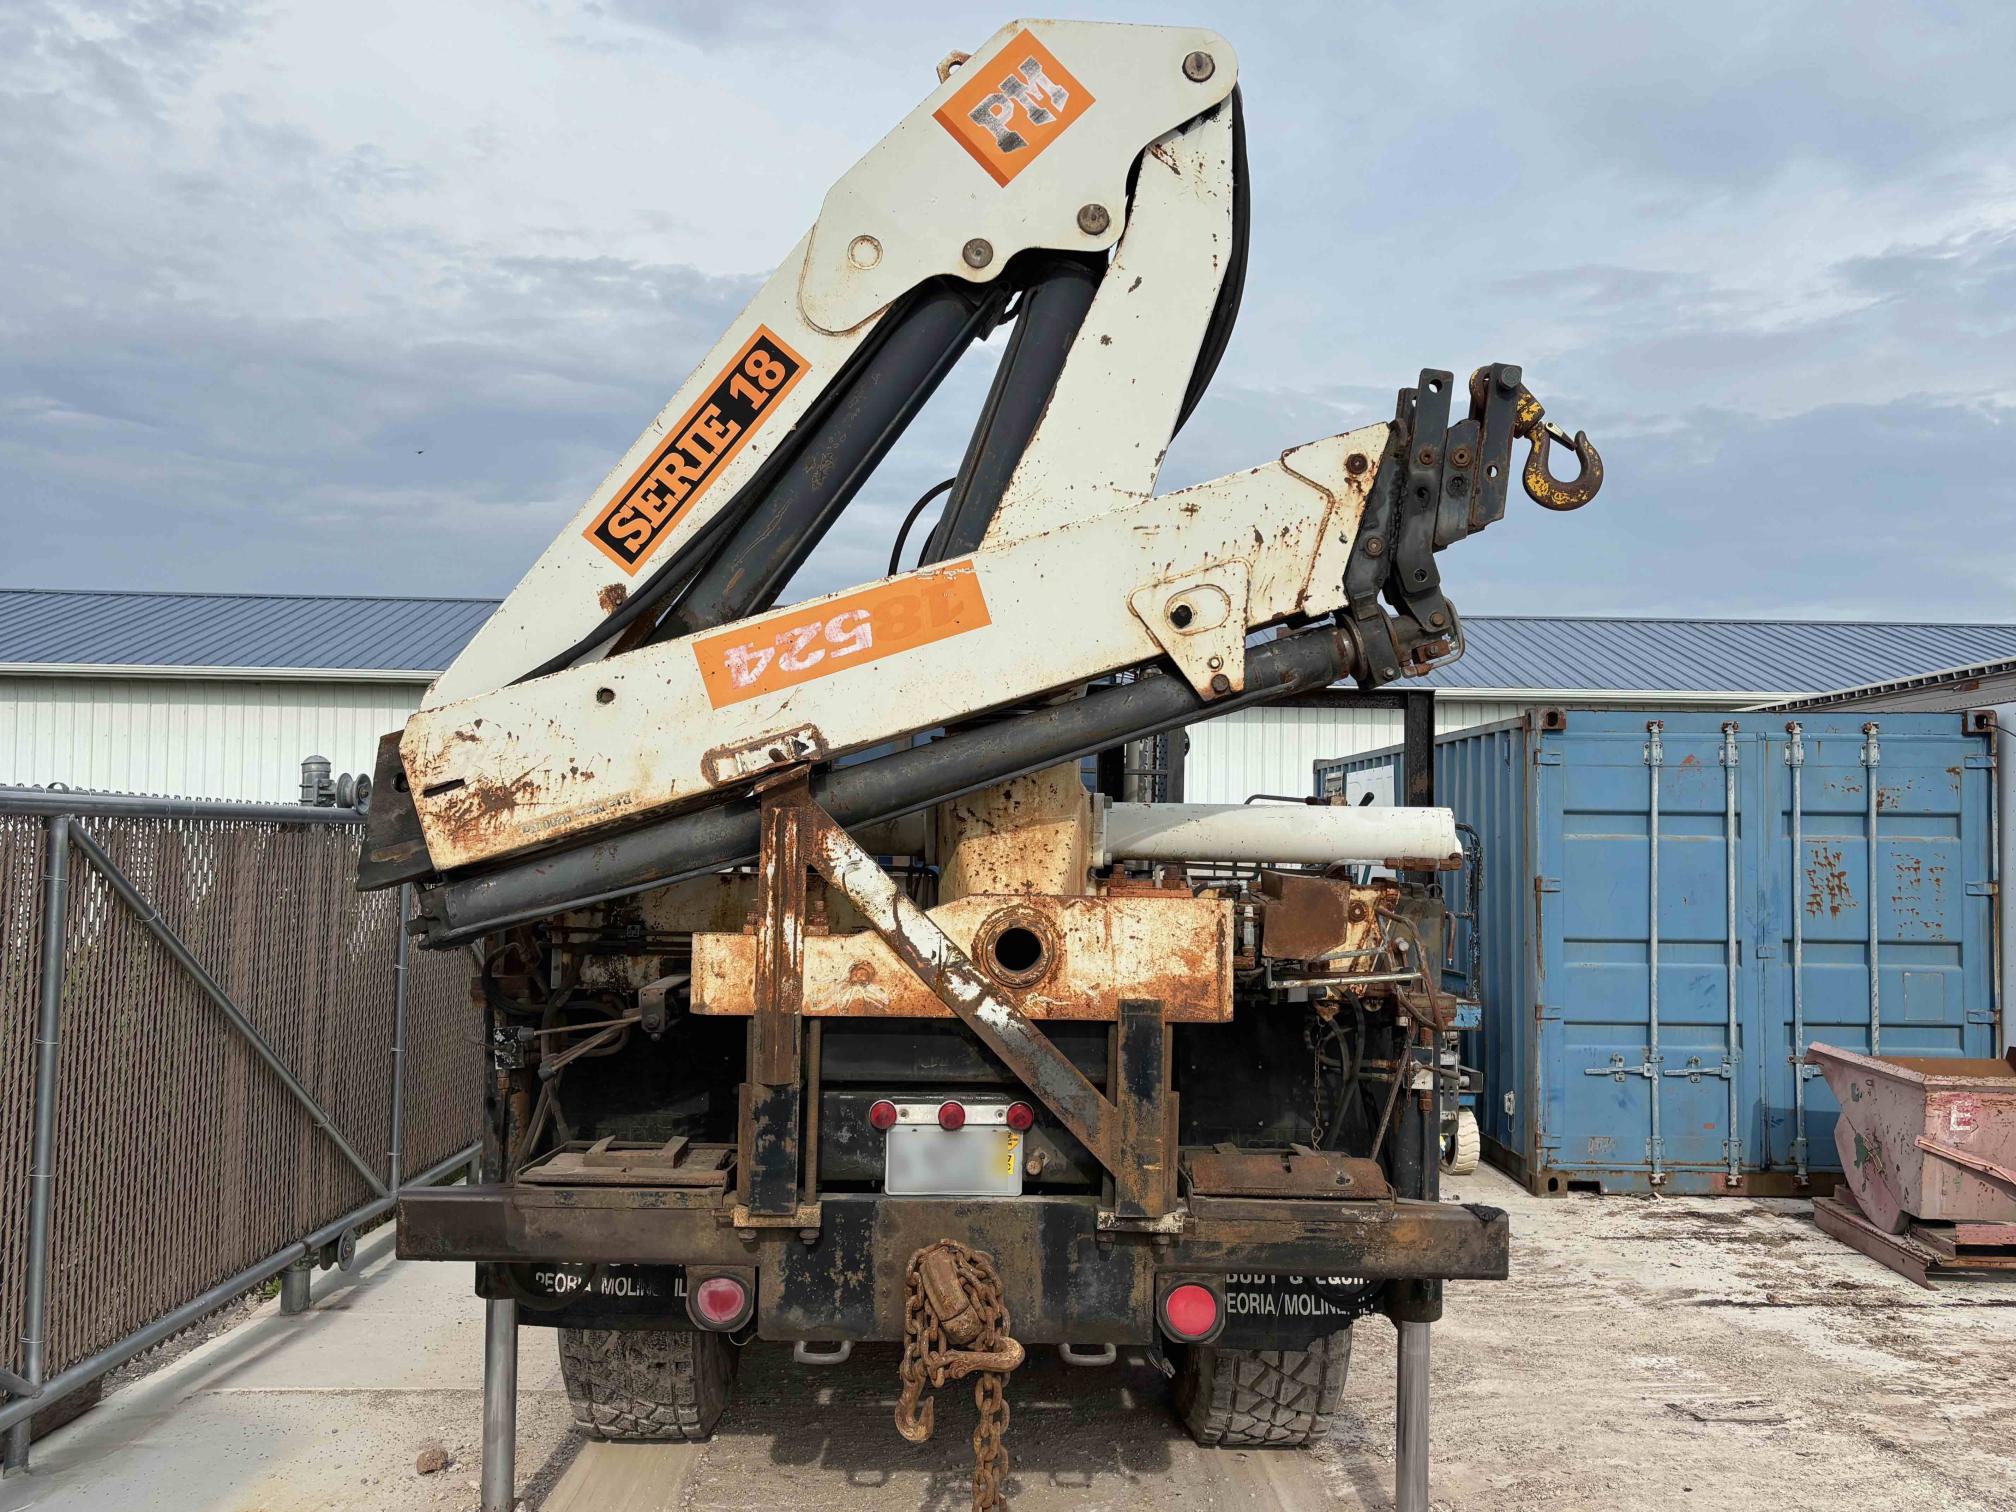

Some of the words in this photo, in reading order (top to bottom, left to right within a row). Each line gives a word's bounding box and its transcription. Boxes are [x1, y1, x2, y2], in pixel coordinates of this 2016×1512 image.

[968, 55, 1069, 153] PM
[607, 402, 742, 553] SERIE
[729, 349, 786, 411] 18
